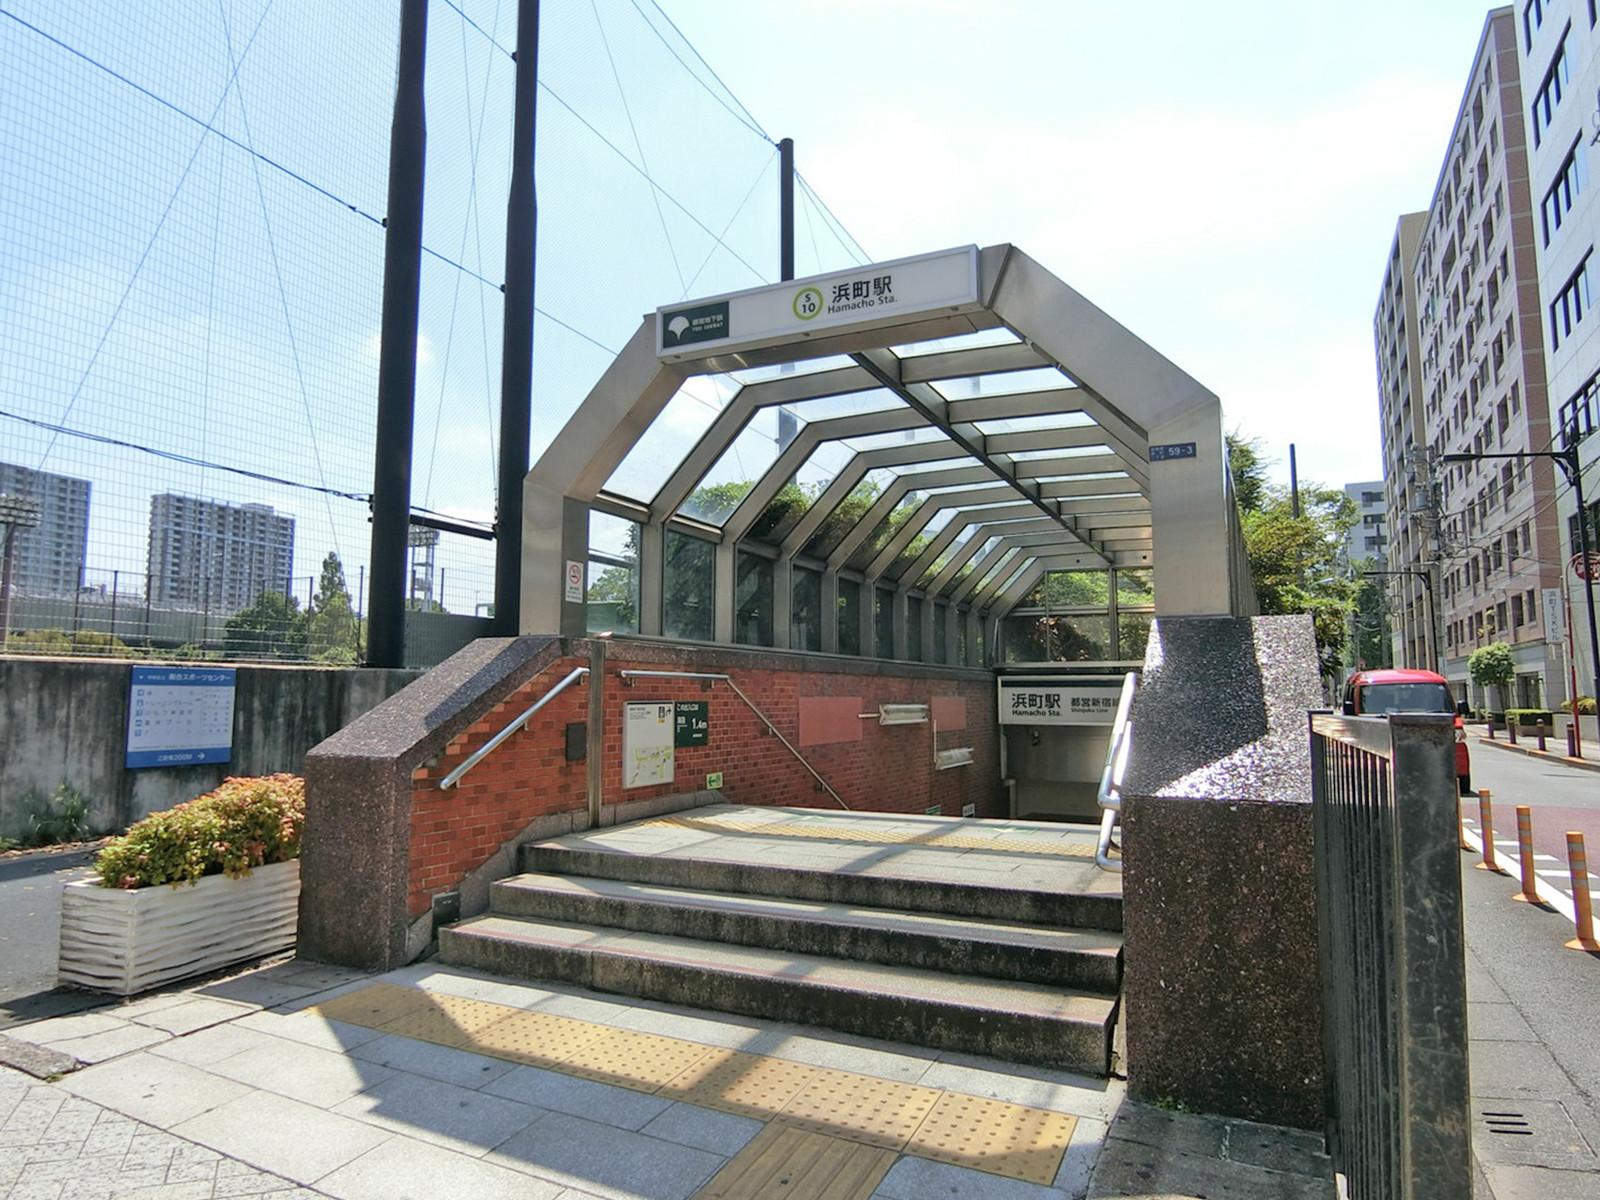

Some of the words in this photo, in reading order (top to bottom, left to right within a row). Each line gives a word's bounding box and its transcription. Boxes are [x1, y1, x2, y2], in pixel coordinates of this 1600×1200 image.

[832, 275, 892, 303] 浜町駅
[804, 293, 811, 303] S
[827, 299, 875, 314] Hamacho
[878, 295, 898, 305] Sta.
[802, 302, 816, 313] 10
[1168, 445, 1193, 456] 59-3
[1011, 693, 1061, 709] 浜町駅
